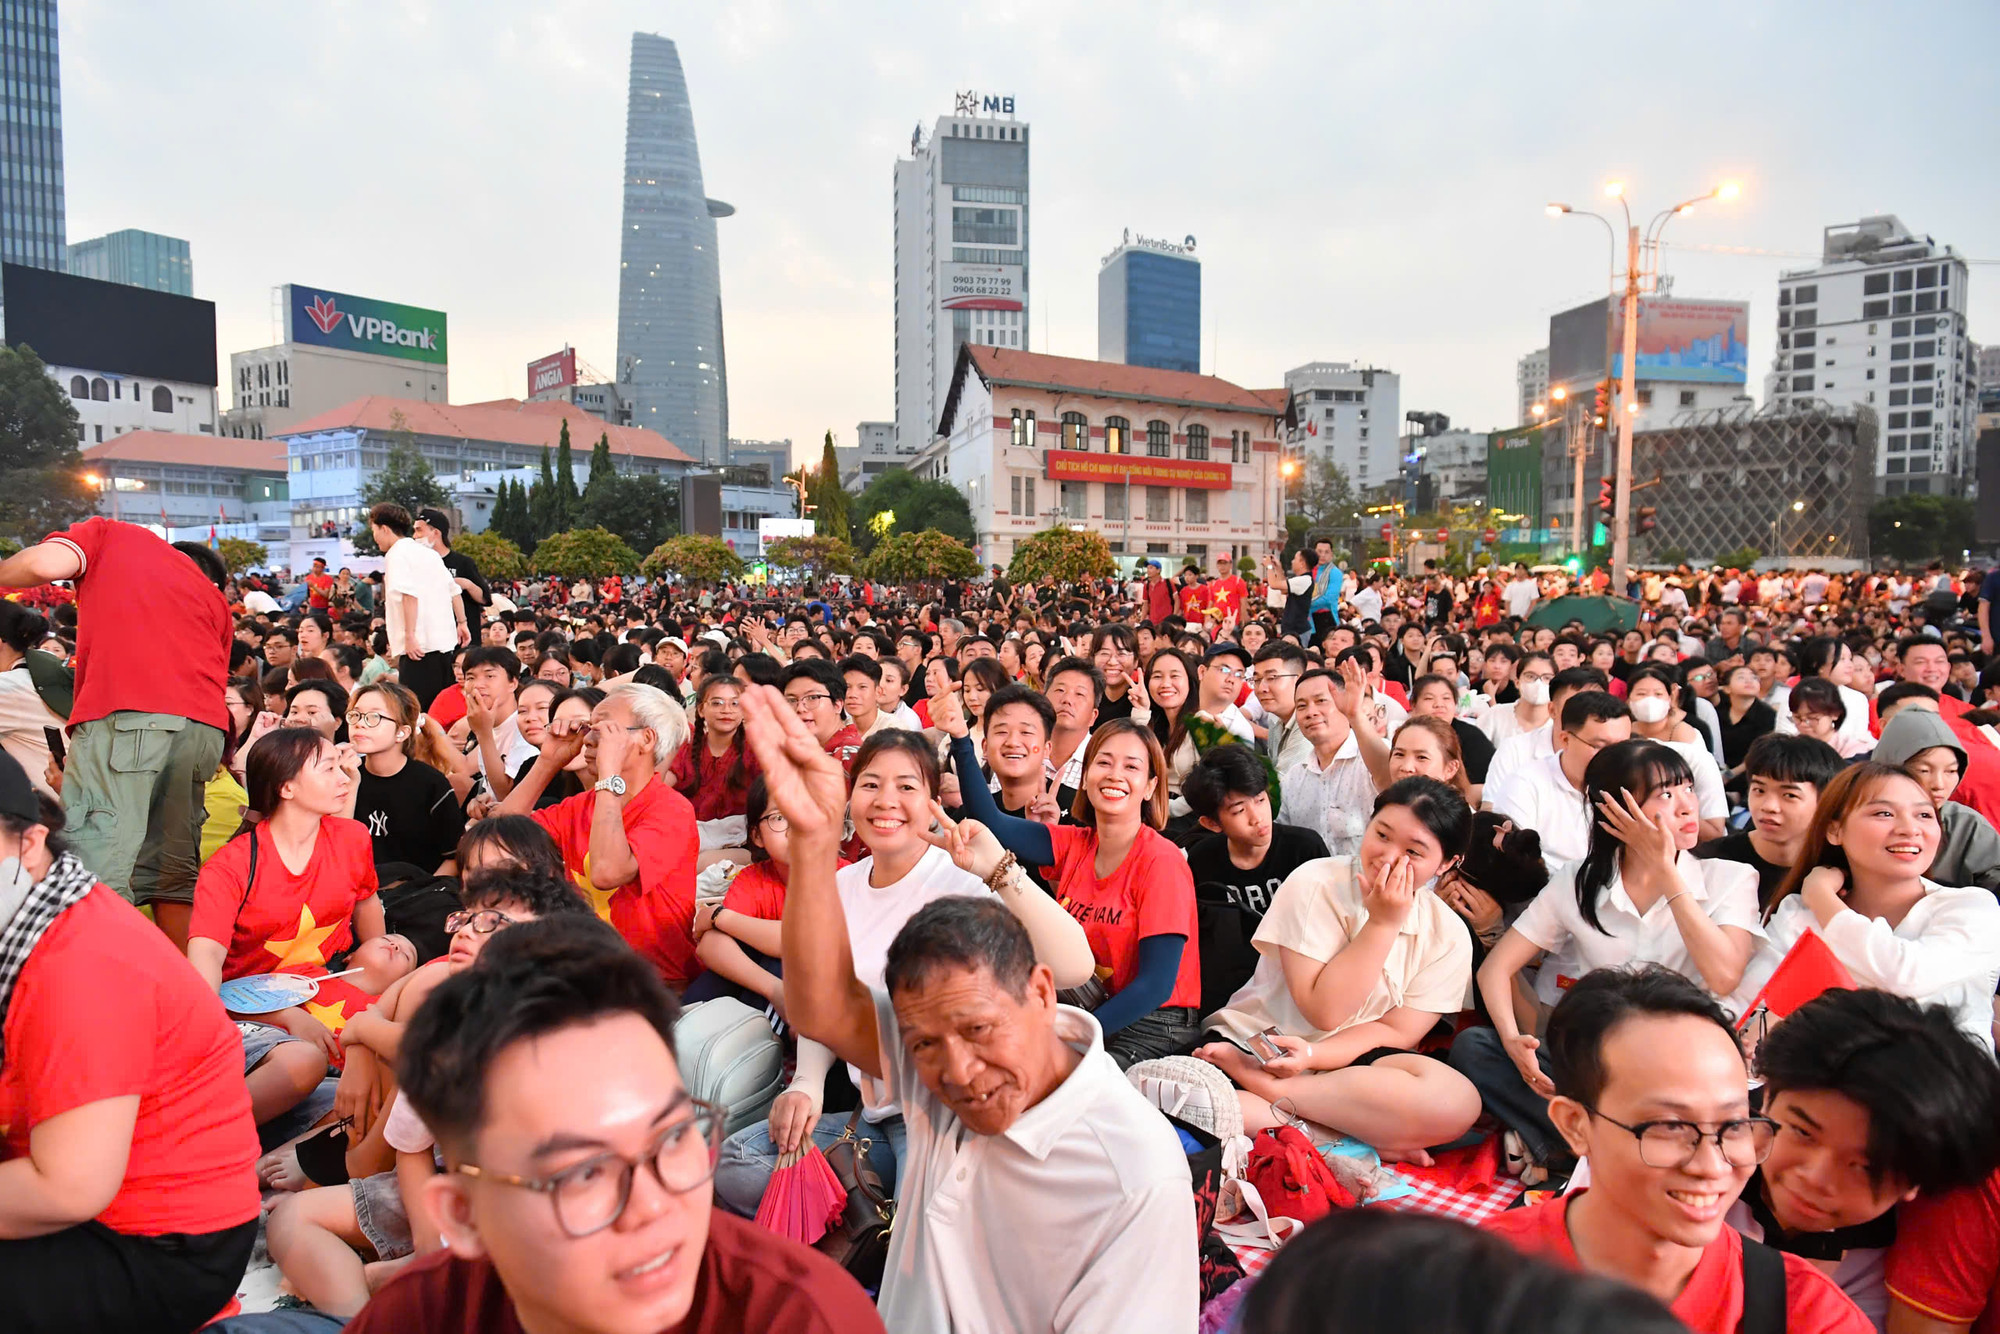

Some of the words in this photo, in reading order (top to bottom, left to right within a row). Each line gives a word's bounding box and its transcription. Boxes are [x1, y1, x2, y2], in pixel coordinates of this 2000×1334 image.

[983, 94, 1016, 113] MB
[1136, 233, 1186, 254] VietinBank
[953, 276, 974, 285] 0903
[976, 277, 987, 285] 79
[1000, 278, 1011, 286] 99
[953, 285, 974, 294] 0906
[976, 286, 987, 294] 68
[989, 287, 999, 295] 22
[1001, 287, 1011, 295] 22
[347, 313, 437, 351] VPBank
[368, 809, 389, 837] NY
